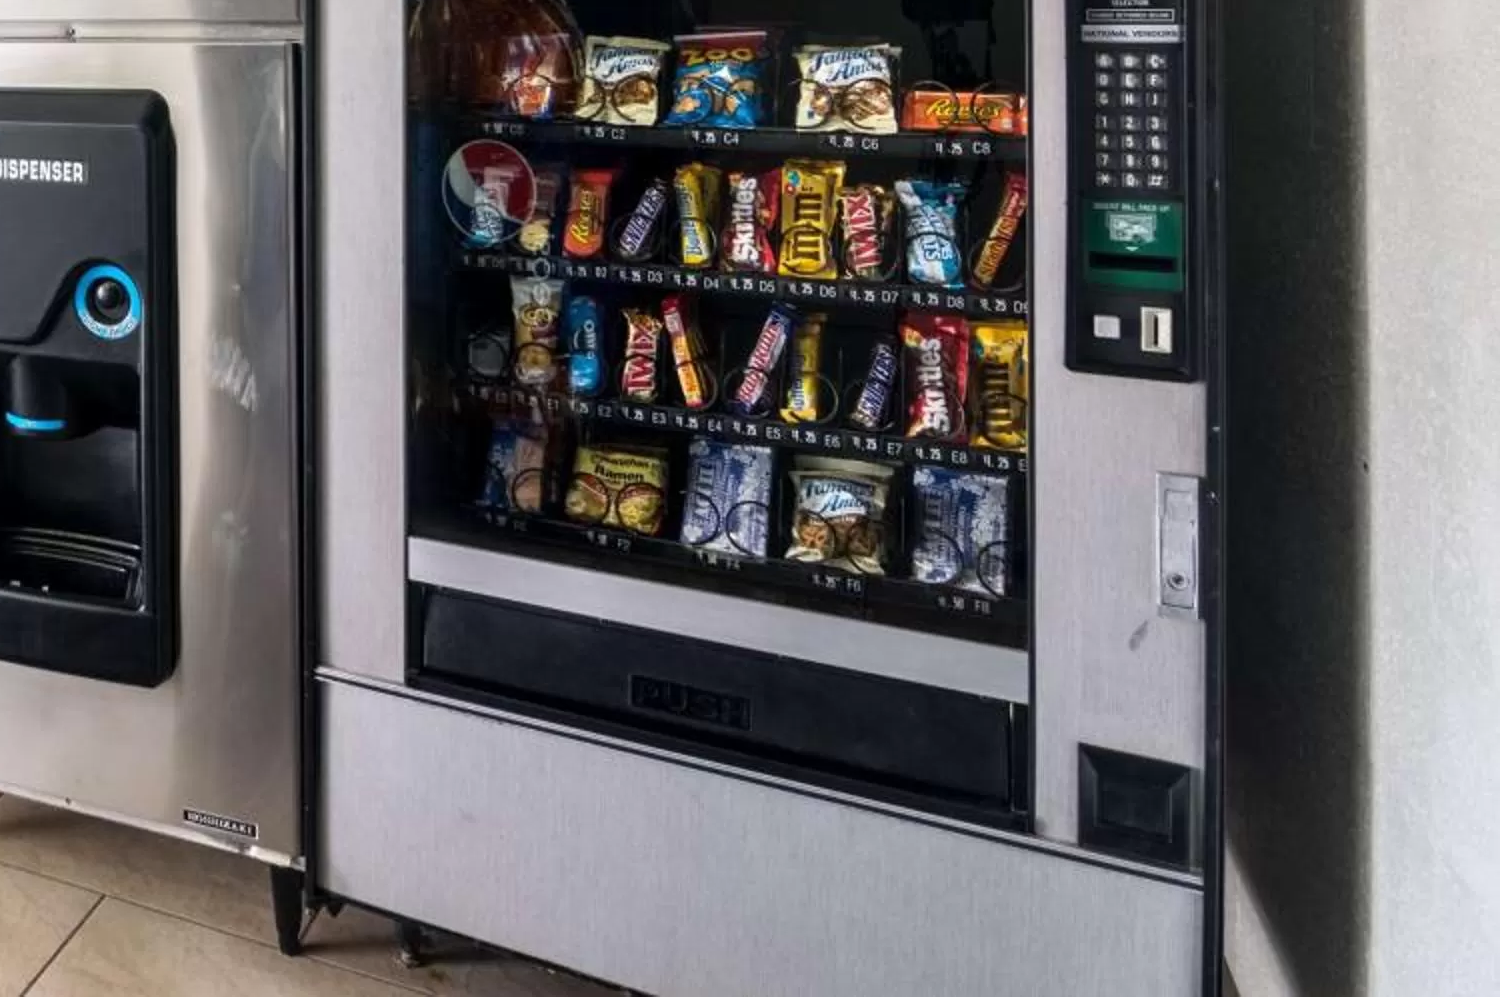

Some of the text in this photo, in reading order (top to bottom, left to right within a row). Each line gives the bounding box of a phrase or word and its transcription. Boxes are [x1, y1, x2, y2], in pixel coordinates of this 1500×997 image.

[723, 132, 740, 145] C4
[973, 142, 991, 154] C8
[732, 177, 759, 261] Skittles
[648, 271, 663, 283] D3
[704, 277, 719, 289] D4
[882, 290, 898, 302] D7
[947, 295, 965, 309] D8
[917, 339, 949, 433] Skittles
[652, 412, 667, 424] E3
[708, 420, 723, 432] E4
[766, 427, 781, 439] E5
[887, 442, 903, 455] E7
[952, 452, 968, 464] E8
[640, 680, 748, 728] PUSH
